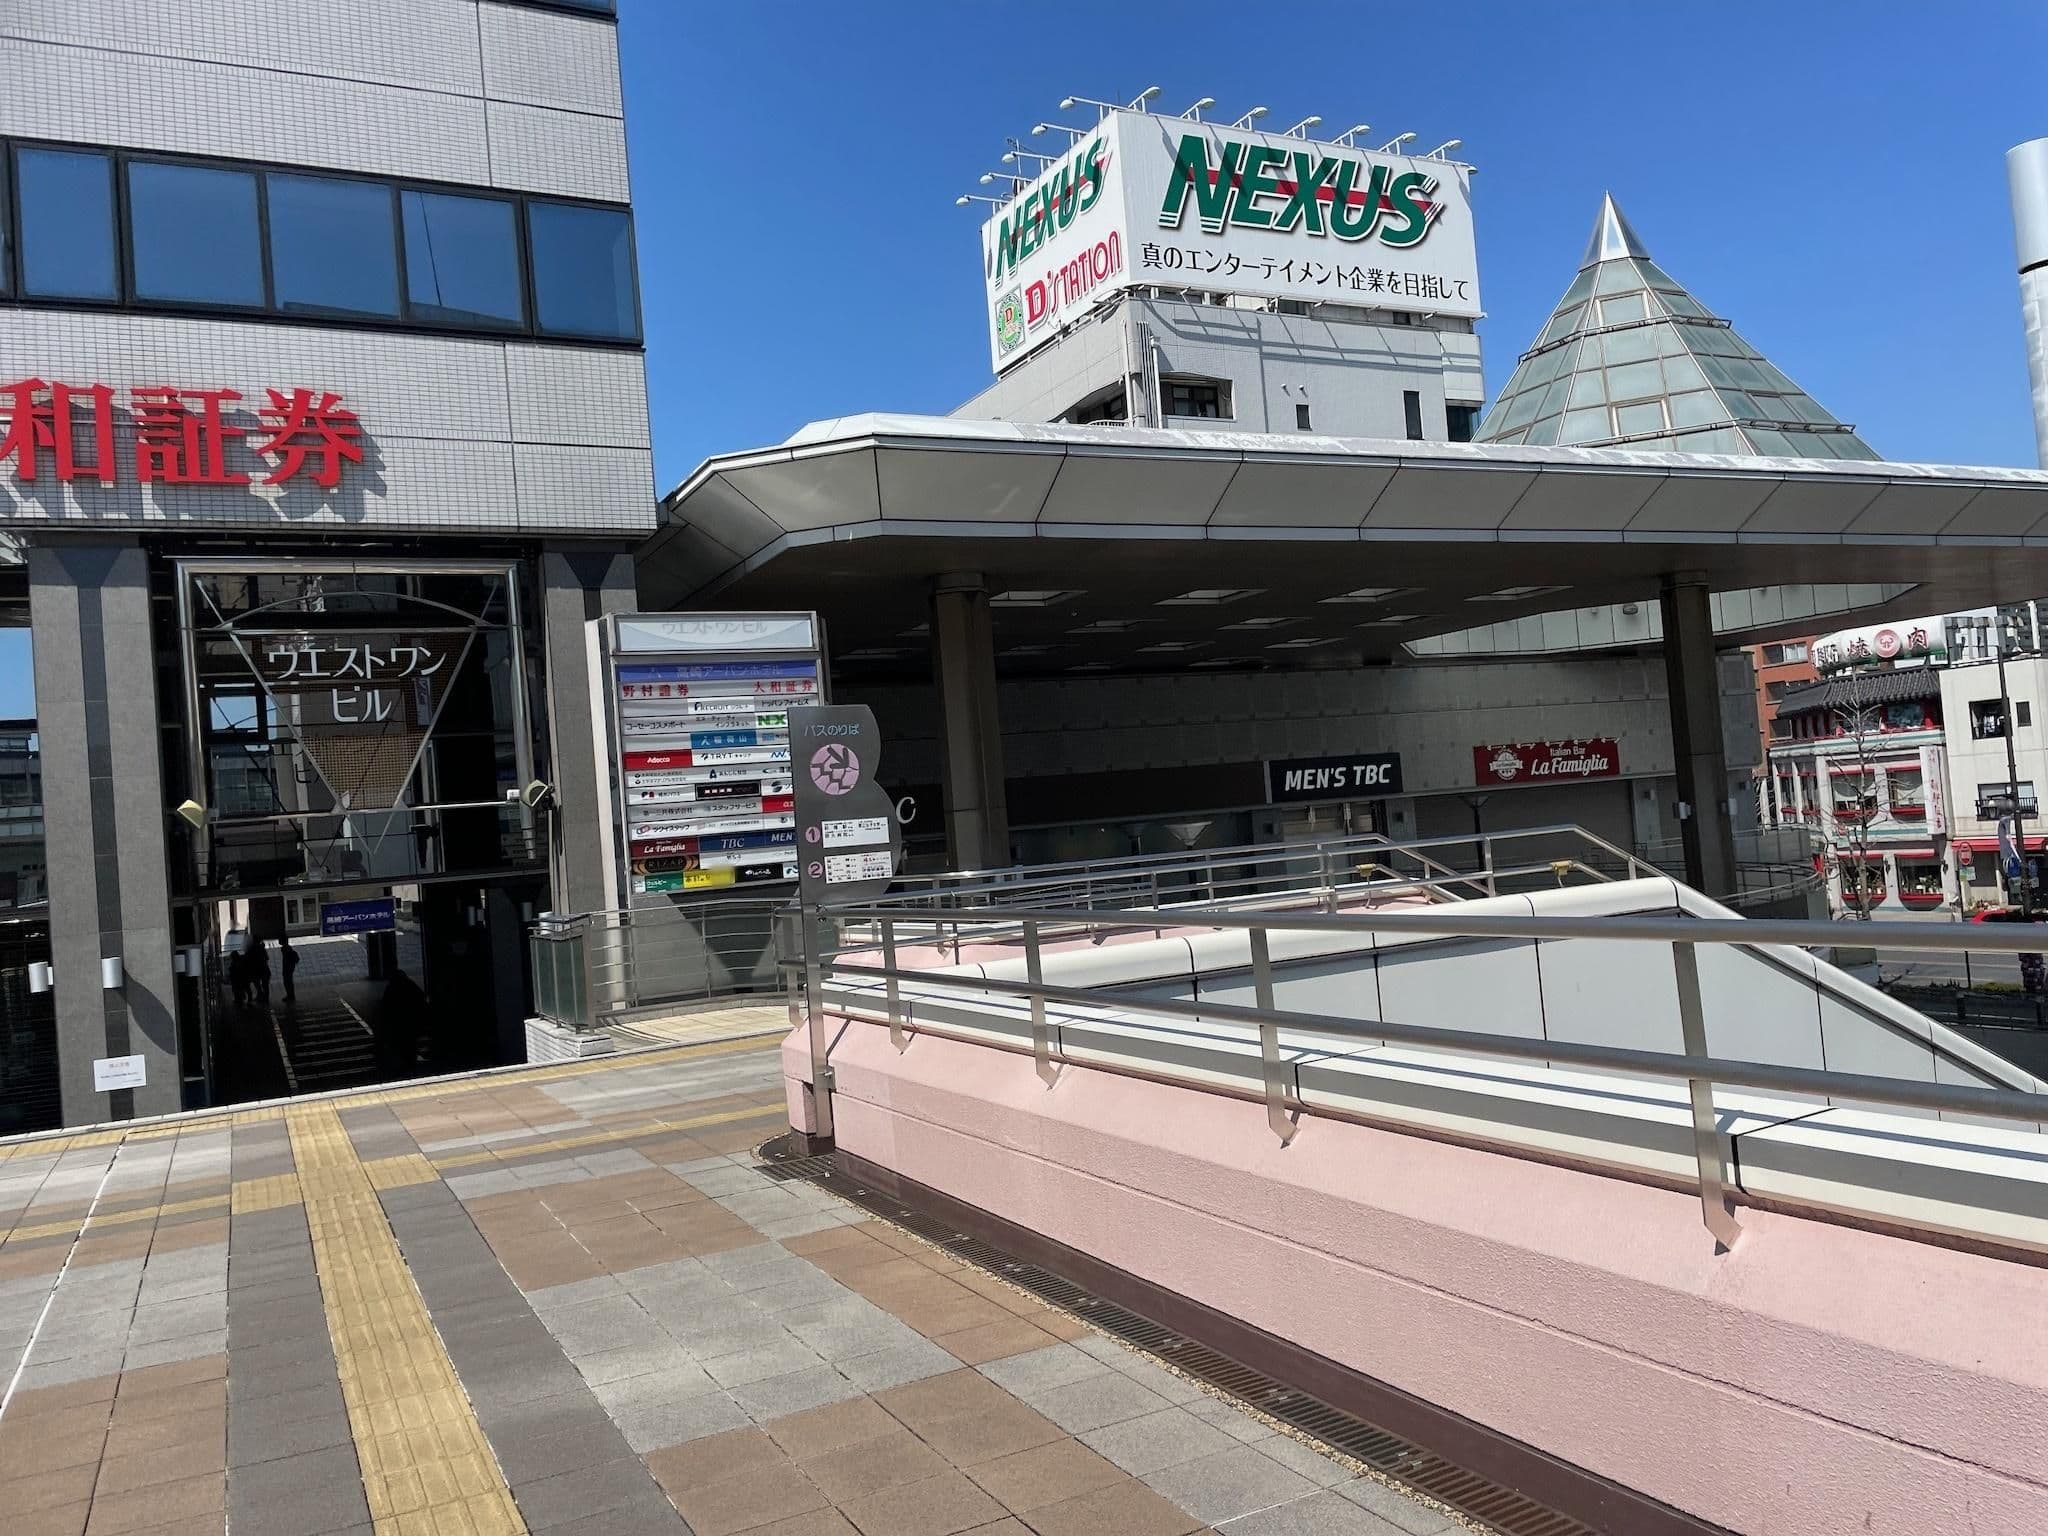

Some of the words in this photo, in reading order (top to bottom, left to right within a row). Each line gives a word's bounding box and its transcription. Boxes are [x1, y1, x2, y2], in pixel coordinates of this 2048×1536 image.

[1158, 133, 1444, 249] NEXUS
[996, 136, 1112, 289] NEXUS
[1141, 243, 1470, 301] 真のエンターテイメント企業を目指して
[0, 377, 363, 488] 和証券
[267, 645, 447, 680] ウエストワン
[331, 685, 394, 725] ビル
[804, 724, 860, 737] バスのりば
[1551, 754, 1609, 776] Famiglia
[1573, 745, 1586, 755] Bar
[1284, 766, 1346, 790] MEN'S
[1352, 763, 1392, 786] TBC
[721, 838, 745, 849] TBC
